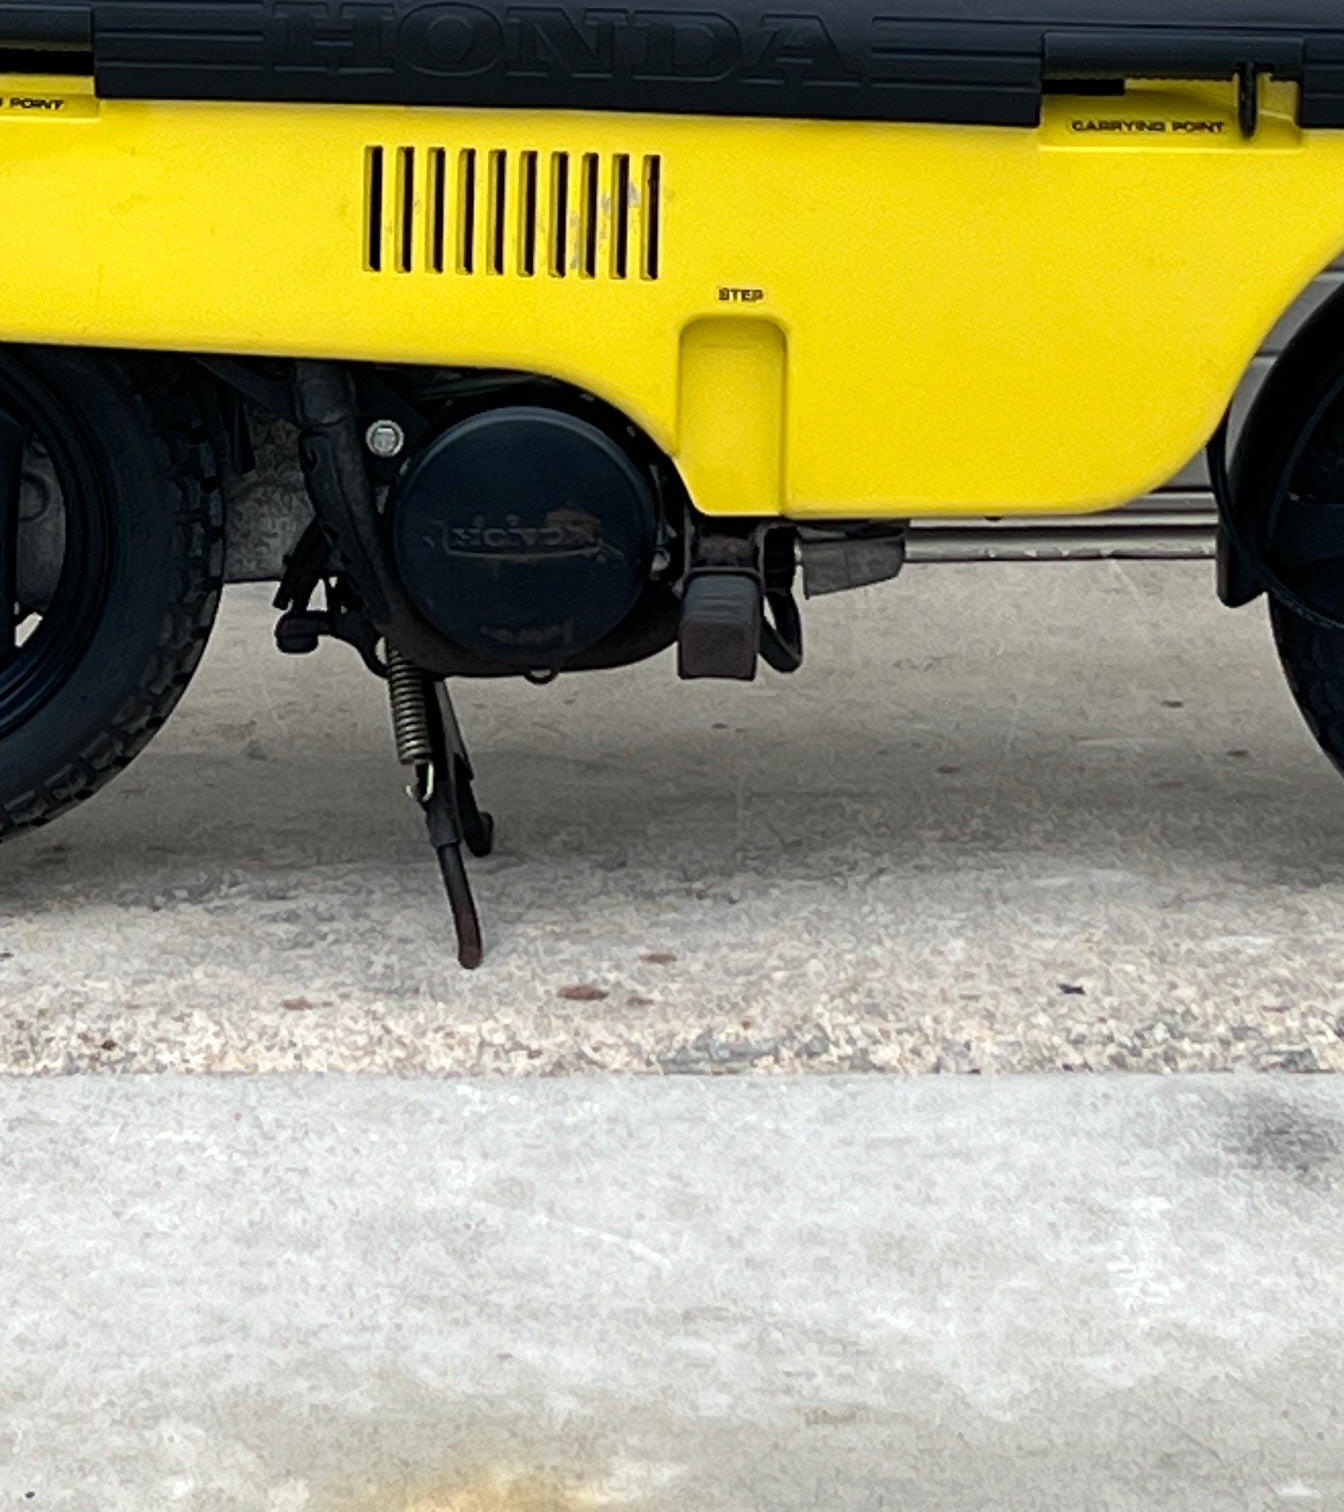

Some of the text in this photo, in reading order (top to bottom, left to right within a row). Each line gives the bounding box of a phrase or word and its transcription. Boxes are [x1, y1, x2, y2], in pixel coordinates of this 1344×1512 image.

[271, 0, 866, 86] HONDA
[9, 96, 64, 110] POINT
[1071, 119, 1225, 133] CARRYING POINT
[718, 287, 764, 302] STEP
